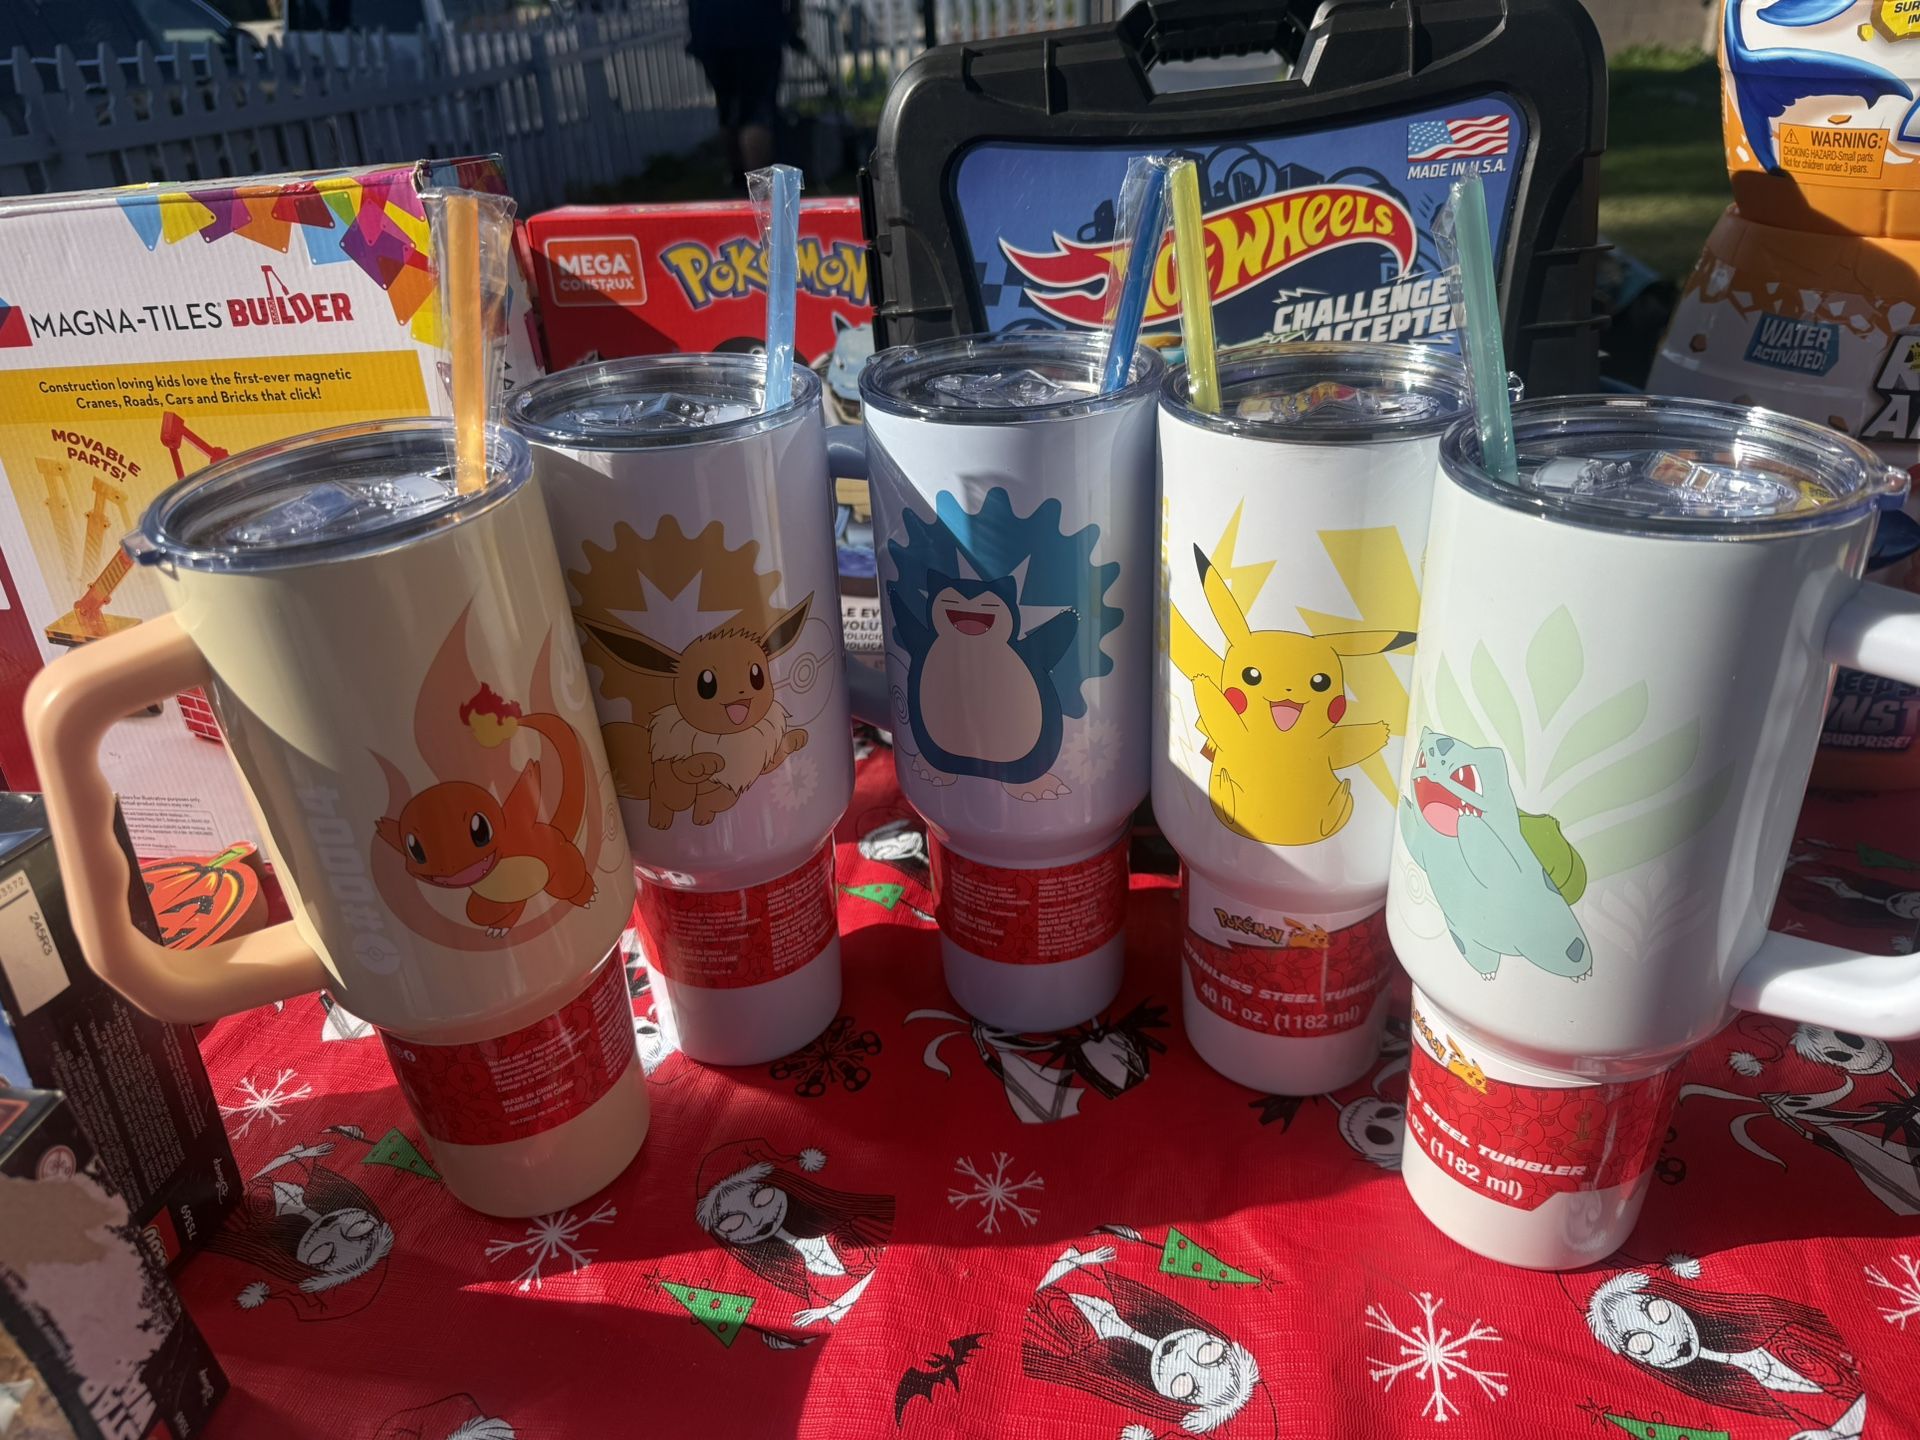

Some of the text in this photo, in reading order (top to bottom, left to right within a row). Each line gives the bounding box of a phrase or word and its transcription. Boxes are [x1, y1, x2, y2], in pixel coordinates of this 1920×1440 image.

[1894, 1, 1920, 13] SUR
[1783, 146, 1810, 158] CHOKING
[1857, 153, 1875, 163] parts.
[1811, 131, 1883, 149] WARNING:
[1407, 162, 1447, 180] MADE
[1451, 161, 1466, 176] IN
[1783, 157, 1869, 175] Not for children under 3 years.
[558, 253, 630, 277] MEGA
[660, 237, 868, 309] Pokmon
[560, 277, 634, 292] CONSTRUX
[227, 288, 354, 328] BUILDER
[1273, 277, 1450, 334] CHALLENGE
[1314, 304, 1454, 342] ACCEPTE
[1758, 317, 1832, 350] WATER
[1752, 344, 1828, 372] ACTIVATED!
[38, 368, 352, 394] Construction loving kids love the first-ever magnetic
[76, 387, 322, 410] Cranes, Roads, Cars and Bricks that click!
[1862, 393, 1920, 439] A
[51, 428, 141, 478] MOVABLE
[67, 446, 127, 482] PARTS!
[1201, 982, 1360, 1031] 40 fl. oz. (1182 ml)
[1258, 987, 1317, 1004] STEEL
[502, 1096, 523, 1105] MADE
[536, 1081, 558, 1095] CHINA
[1422, 1101, 1471, 1148] STEEL
[1477, 1142, 1586, 1176] TUMBLER
[1430, 1134, 1480, 1182] (1182
[1485, 1174, 1523, 1200] ml)
[181, 1204, 197, 1241] 75369
